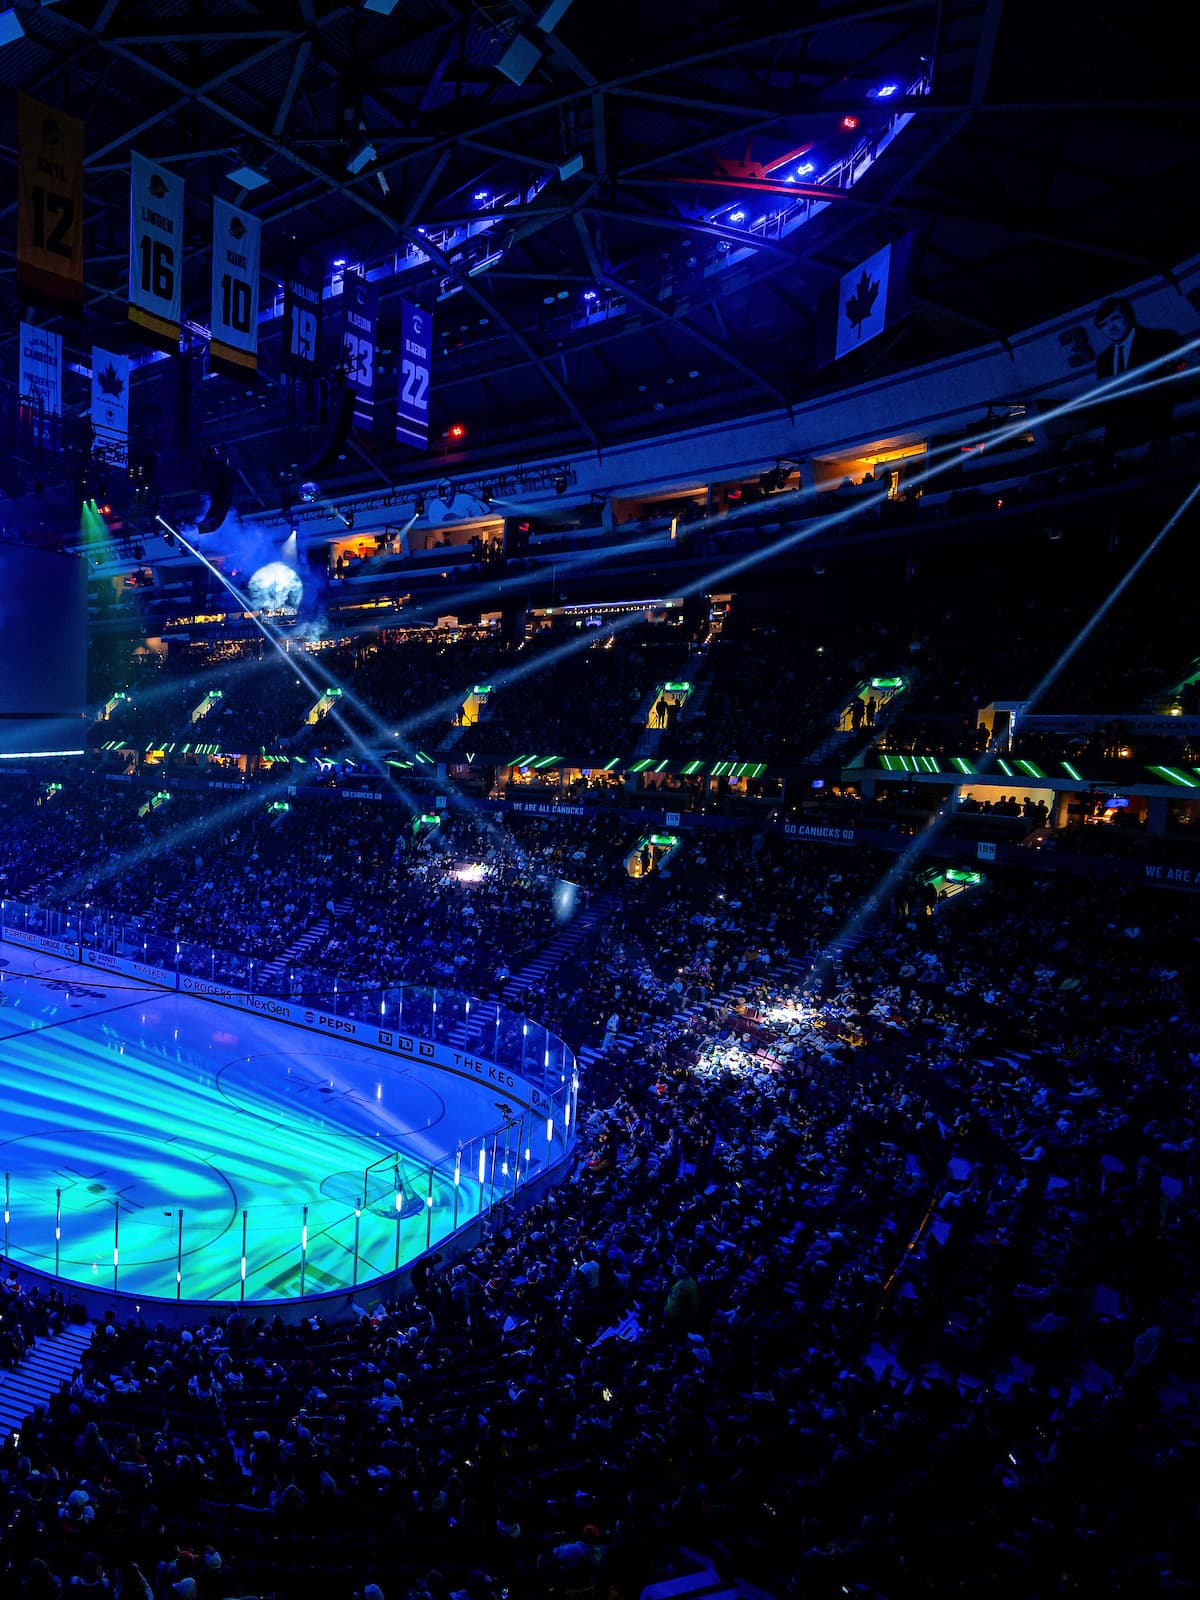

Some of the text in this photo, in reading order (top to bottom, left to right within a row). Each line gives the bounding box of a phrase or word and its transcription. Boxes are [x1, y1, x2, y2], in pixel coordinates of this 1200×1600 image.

[32, 185, 73, 258] 12
[142, 205, 173, 234] LINDEN
[141, 234, 174, 300] 16
[226, 248, 247, 270] BURE
[221, 273, 251, 333] 10
[290, 304, 317, 362] 19
[343, 331, 374, 387] 33
[402, 359, 429, 410] 22
[513, 802, 584, 815] WE ARE ALL CANUCKS
[784, 824, 854, 840] GO CANUCKS GO
[1145, 865, 1163, 879] WE
[1166, 866, 1191, 882] ARE
[194, 981, 232, 1000] ROGERS
[246, 995, 290, 1017] NexGen
[319, 1016, 356, 1034] PEPSI
[380, 1033, 393, 1044] TD
[400, 1038, 413, 1050] TD
[420, 1043, 434, 1055] TD
[454, 1053, 514, 1088] THE KEG
